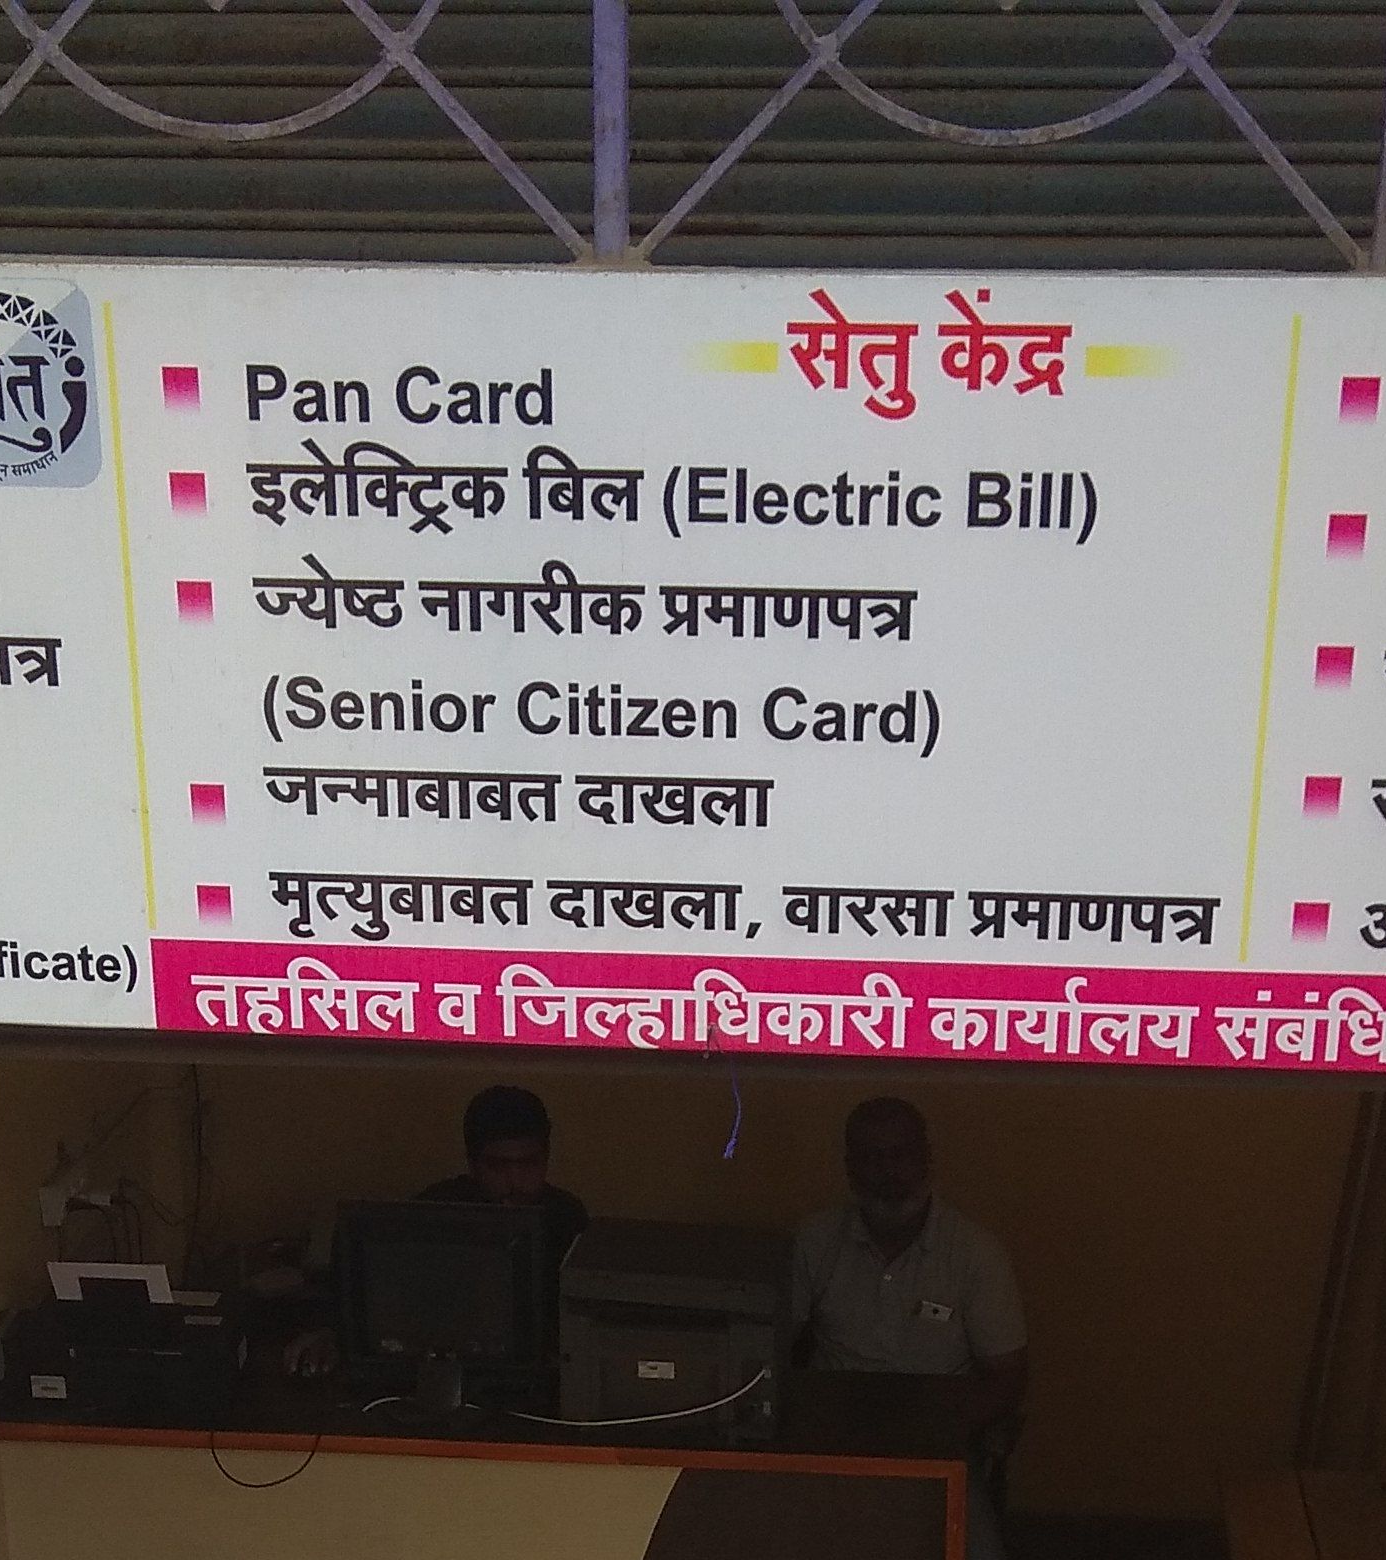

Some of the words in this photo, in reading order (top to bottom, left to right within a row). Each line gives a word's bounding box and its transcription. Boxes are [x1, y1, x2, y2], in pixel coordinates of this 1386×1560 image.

[246, 365, 370, 422] Pan
[396, 366, 552, 425] Card
[787, 289, 918, 420] सेतु
[938, 289, 1072, 395] केंद्र
[246, 438, 508, 534] इलेक्ट्रिक
[522, 446, 644, 521] बिल
[663, 466, 941, 538] (Electric
[967, 472, 1097, 544] Bill)
[253, 554, 404, 628] ज्येष्ठ
[418, 560, 645, 635] नागरीक
[659, 586, 918, 640] प्रमाणपत्र
[264, 675, 496, 742] (Senior
[518, 682, 736, 738] Citizen
[763, 687, 939, 757] Card)
[263, 767, 561, 821] जन्माबाबत
[575, 775, 774, 827] दाखला
[269, 872, 533, 941] मृत्युबाबत
[547, 880, 761, 938] दाखला,
[783, 887, 954, 936] वारसा
[968, 891, 1220, 944] प्रमाणपत्र
[191, 957, 419, 1034] तहसिल
[434, 983, 481, 1035] व
[496, 964, 913, 1049] जिल्हाधिकारी
[928, 977, 1199, 1057] कार्यालय
